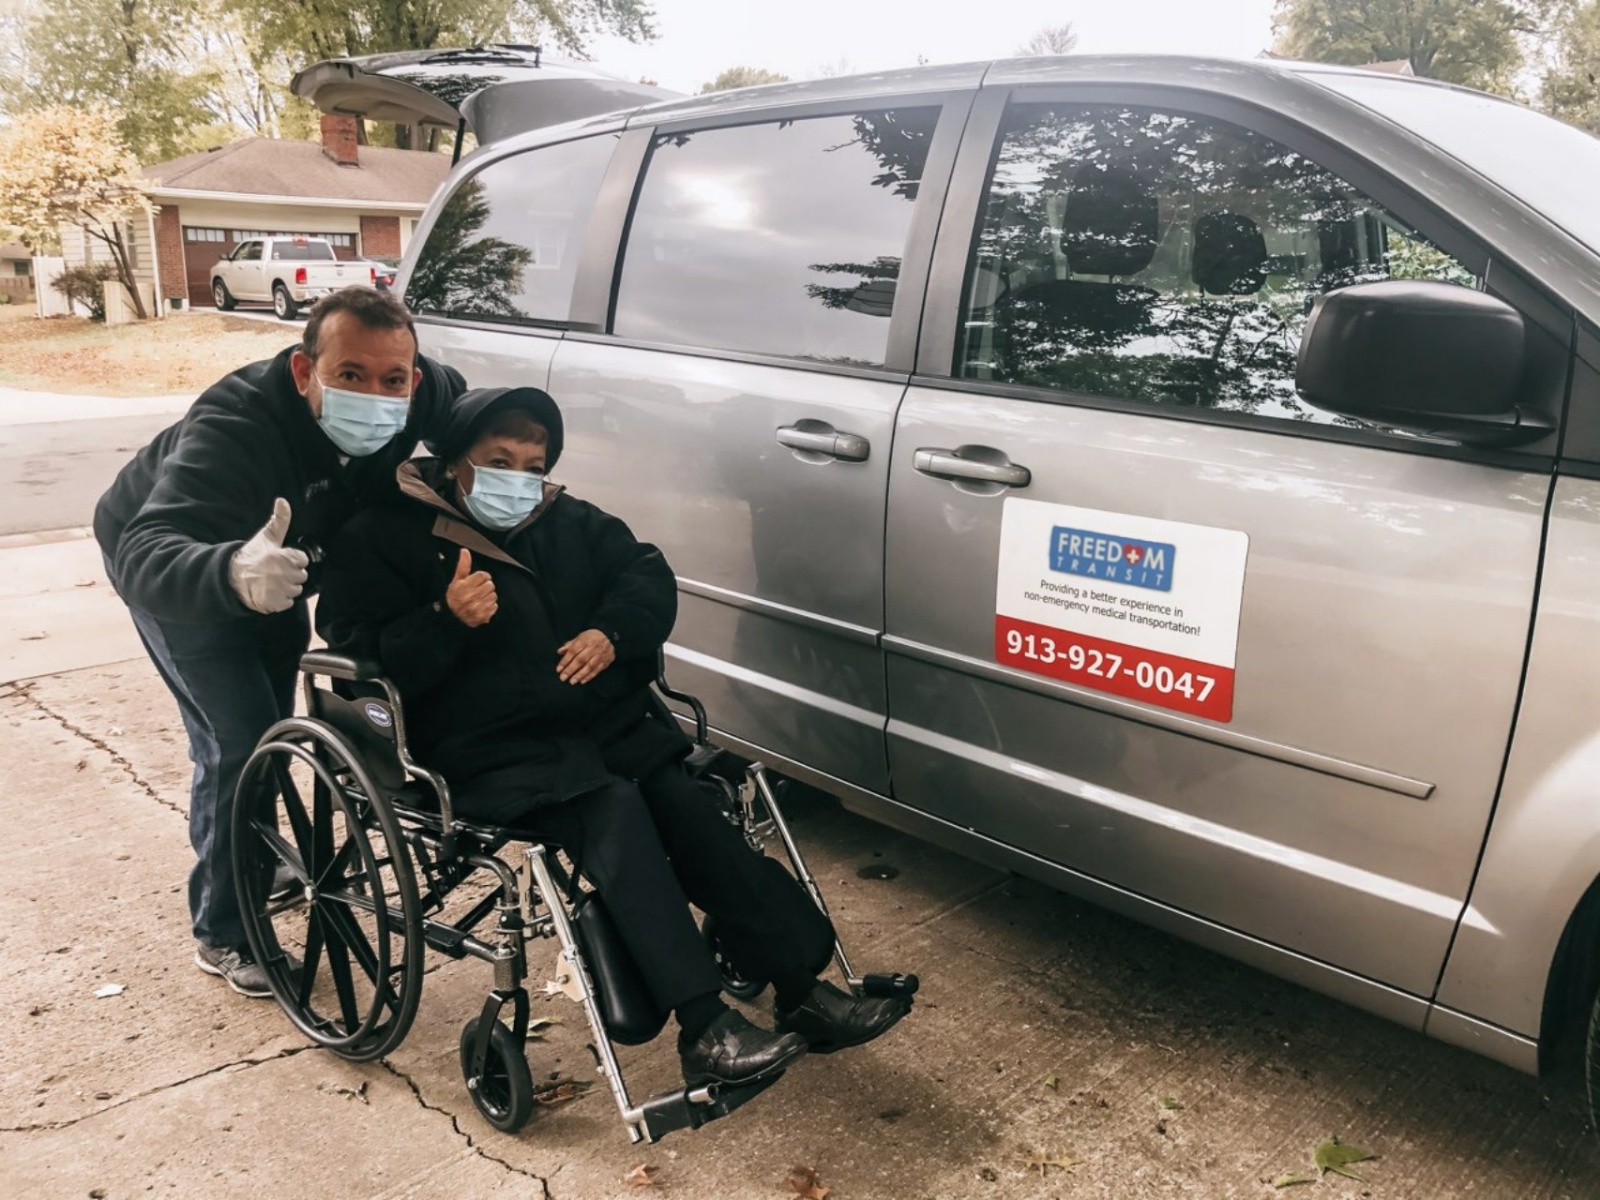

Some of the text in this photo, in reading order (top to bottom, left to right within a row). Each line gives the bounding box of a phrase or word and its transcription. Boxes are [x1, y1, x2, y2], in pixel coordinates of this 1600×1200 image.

[1057, 556, 1163, 586] TRANSIT
[1058, 533, 1165, 571] FREEDM
[1024, 590, 1201, 637] non-emergency medical transportation!
[1040, 580, 1184, 618] Providing a better experience in
[1006, 630, 1216, 703] 913-927-0047
